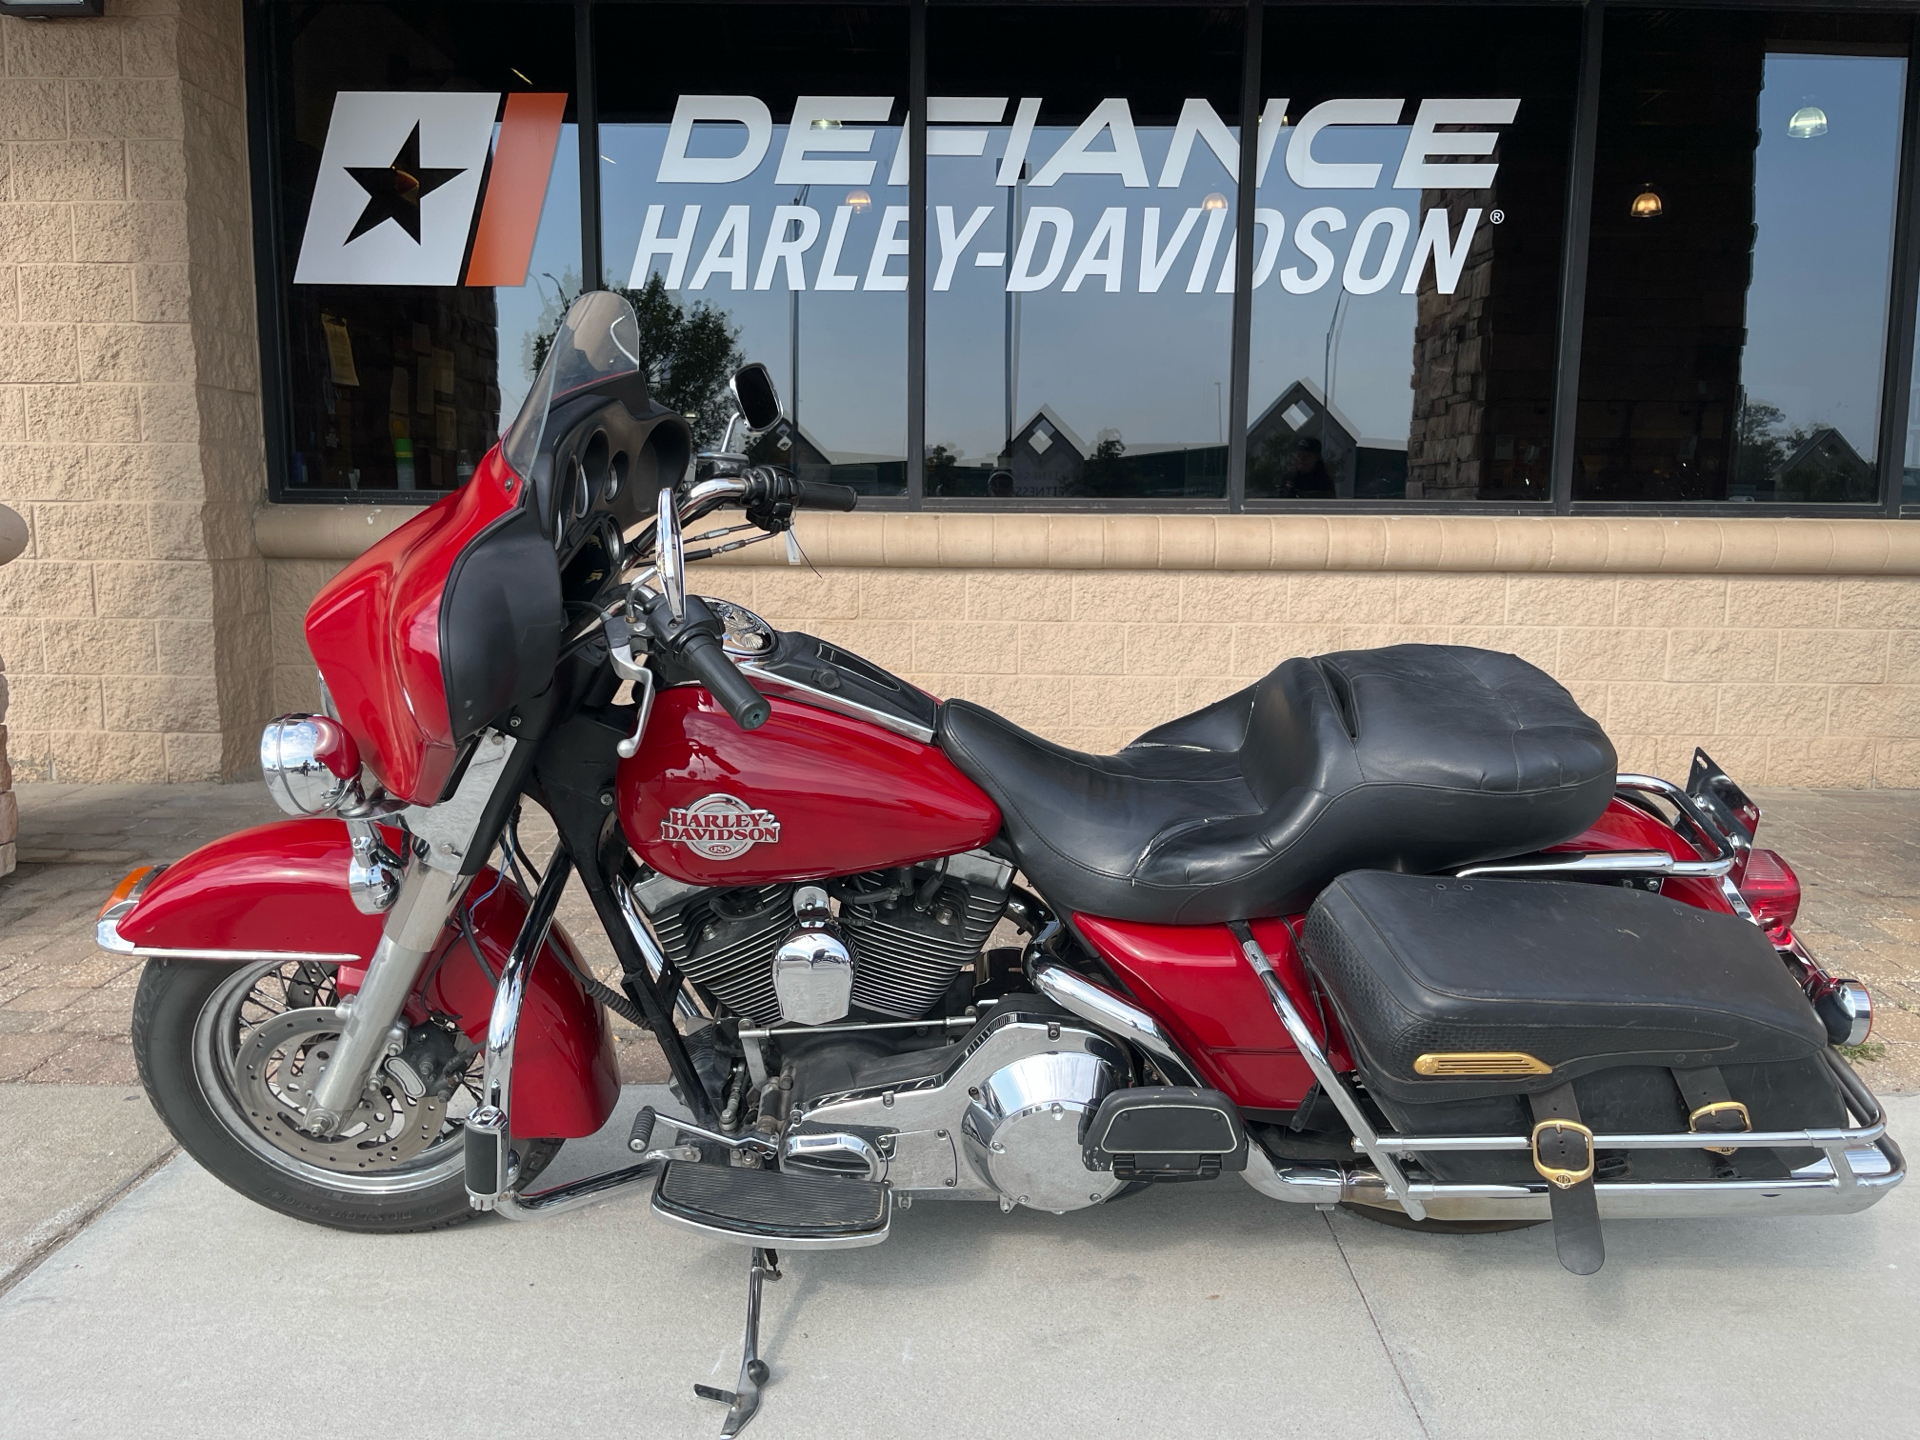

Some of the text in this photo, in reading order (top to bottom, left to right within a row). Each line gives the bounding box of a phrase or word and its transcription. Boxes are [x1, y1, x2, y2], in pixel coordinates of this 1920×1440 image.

[656, 94, 1521, 189] DEFIANCE
[670, 811, 772, 828] HARLEY-
[663, 825, 778, 841] DAVIDSON
